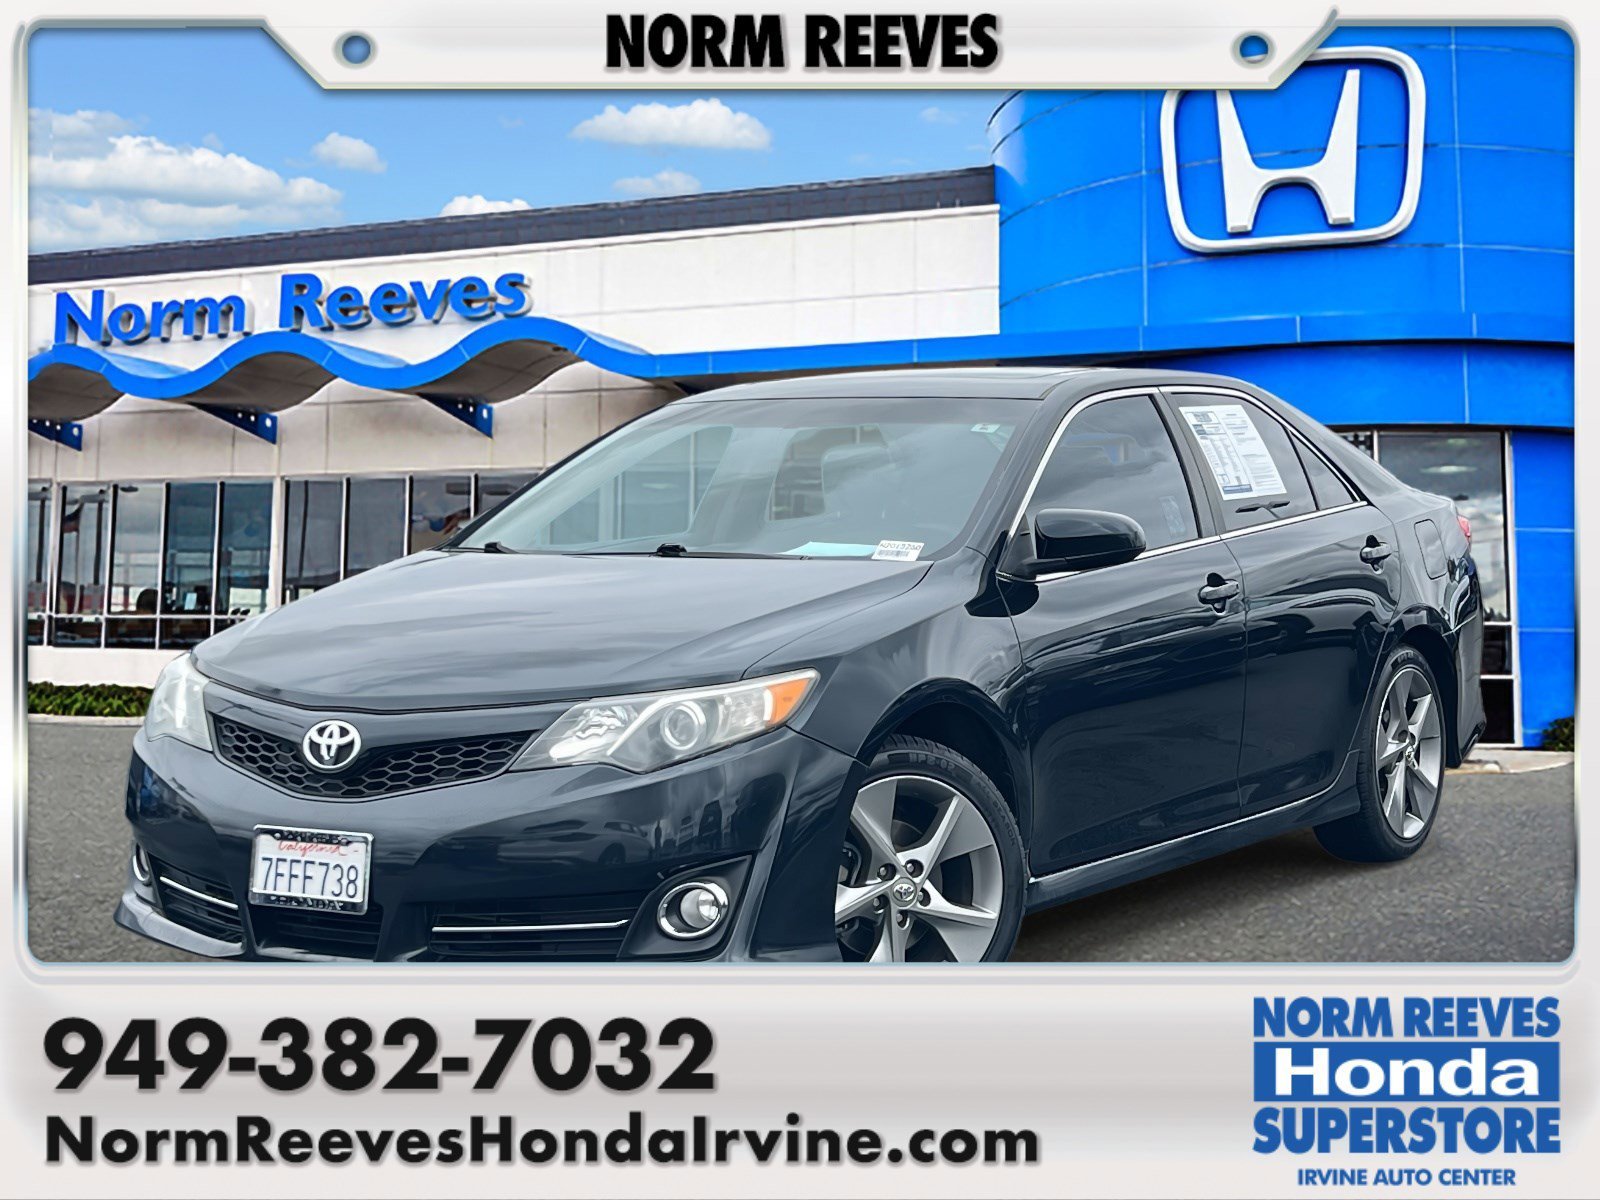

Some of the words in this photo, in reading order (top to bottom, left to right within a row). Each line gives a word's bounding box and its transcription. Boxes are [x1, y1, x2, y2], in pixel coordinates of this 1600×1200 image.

[54, 288, 252, 344] Norm
[280, 272, 531, 330] Reeves
[261, 857, 359, 899] 7FFF738
